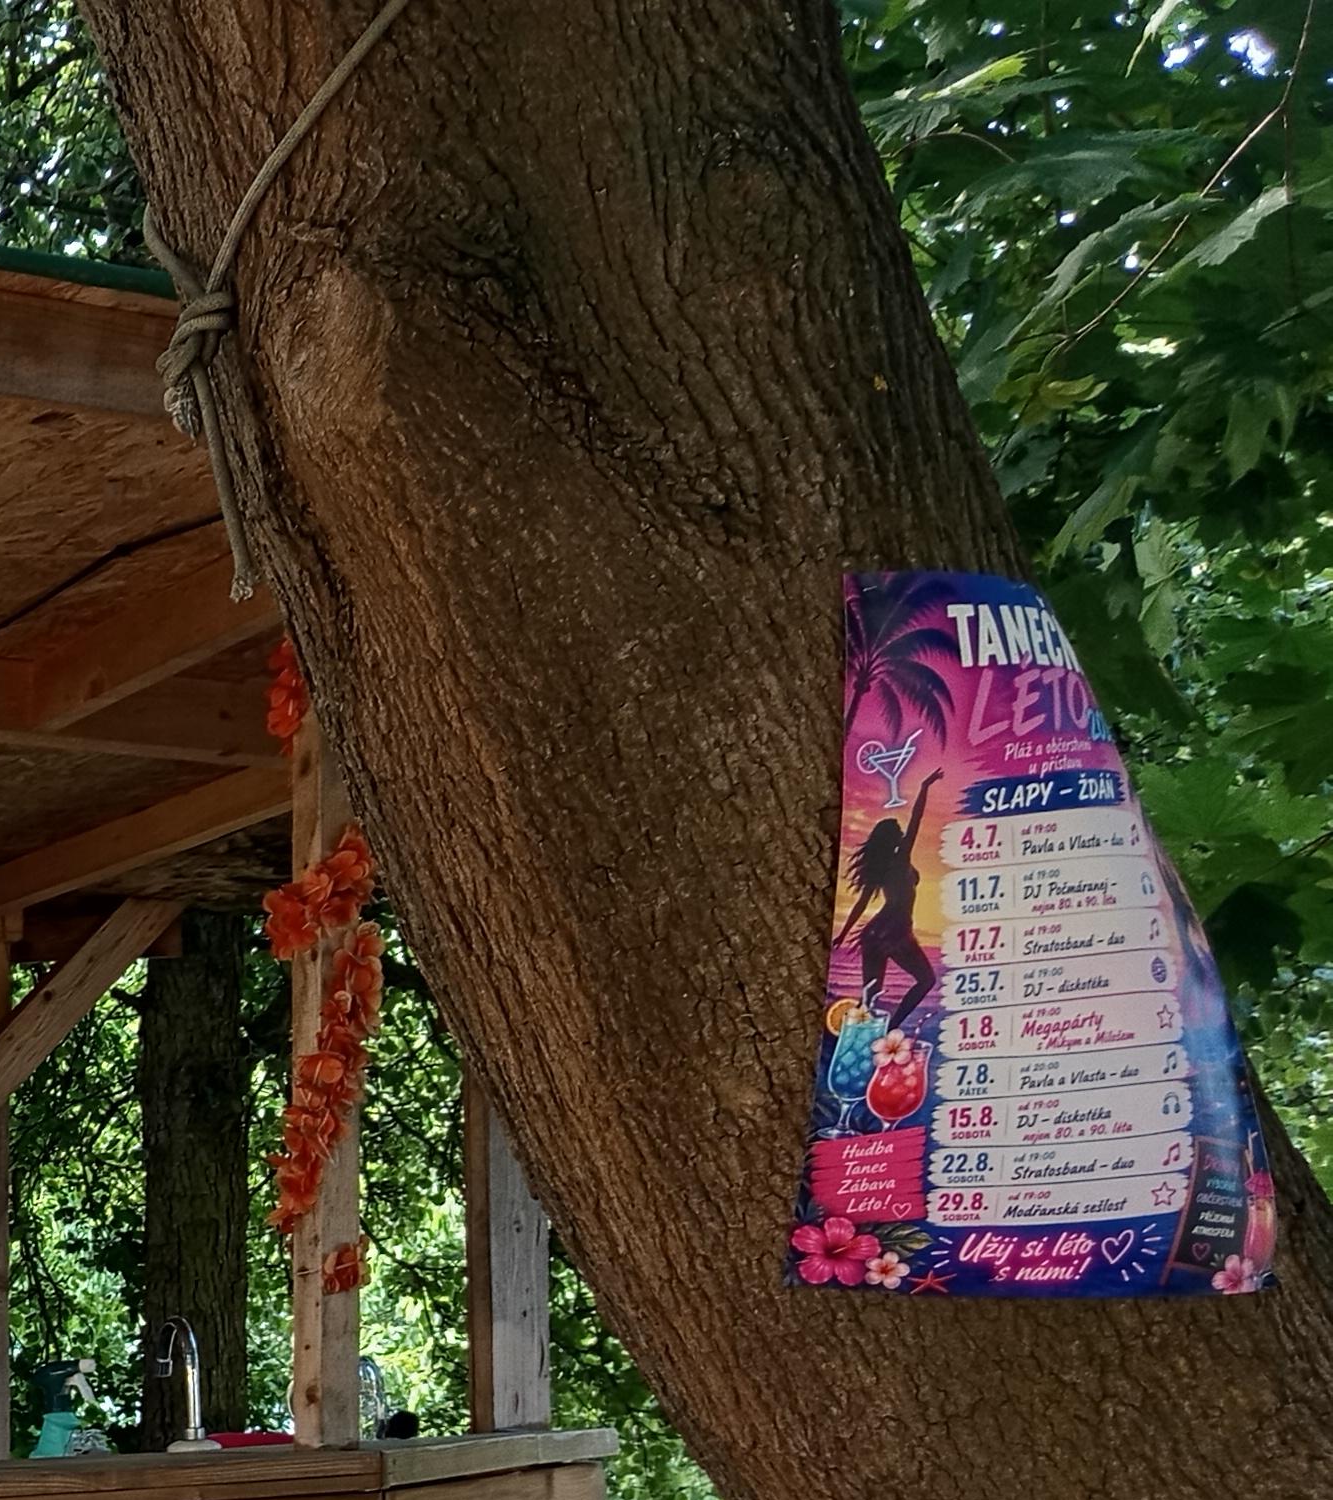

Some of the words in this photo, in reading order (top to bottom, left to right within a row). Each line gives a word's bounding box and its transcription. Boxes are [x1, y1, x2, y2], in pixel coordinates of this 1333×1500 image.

[967, 650, 1090, 746] LÉTO
[1004, 740, 1032, 762] Pláž
[982, 781, 1054, 813] SLAPY
[1078, 773, 1115, 801] ŽDÁŇ
[960, 824, 1002, 850] 4.7.
[1022, 838, 1054, 856] Pavla
[1057, 841, 1065, 851] a
[962, 851, 1001, 863] SOBOTA
[957, 875, 1005, 901] 11.7.
[1023, 885, 1042, 900] DJ
[961, 903, 1000, 915] SOBOTA
[957, 926, 1005, 951] 17.7.
[965, 951, 995, 963] PÁTEK
[954, 970, 1005, 995] 25.7.
[1023, 982, 1043, 998] DJ
[961, 995, 997, 1006] SOBOTA
[959, 1015, 999, 1039] 1.8.
[1020, 1010, 1104, 1041] Megapárty
[958, 1040, 996, 1051] SOBOTA
[956, 1063, 995, 1086] 7.8.
[1020, 1074, 1054, 1090] Pavla
[1058, 1077, 1066, 1086] a
[1071, 1070, 1107, 1086] Vlasta
[959, 1086, 989, 1097] PÁTEK
[949, 1105, 998, 1128] 15.8.
[1016, 1113, 1038, 1129] DJ
[1054, 1106, 1112, 1126] diskotéka
[951, 1129, 992, 1141] SOBOTA
[842, 1140, 894, 1159] Hudba
[844, 1161, 888, 1176] Tanec
[941, 1152, 994, 1175] 22.8.
[1011, 1160, 1095, 1181] Stratosband
[1111, 1157, 1135, 1171] duo
[836, 1178, 896, 1195] Zábava
[947, 1175, 985, 1184] SOBOTA
[846, 1194, 893, 1214] Léto!
[937, 1191, 989, 1213] 29.8.
[1002, 1202, 1079, 1219] Modřanská
[1083, 1197, 1128, 1215] sešlost
[942, 1212, 981, 1222] SOBOTA
[958, 1232, 1018, 1266] Užij
[1020, 1236, 1048, 1259] si
[1051, 1232, 1096, 1257] léto
[993, 1266, 1010, 1282] s
[1015, 1256, 1093, 1281] námi!
